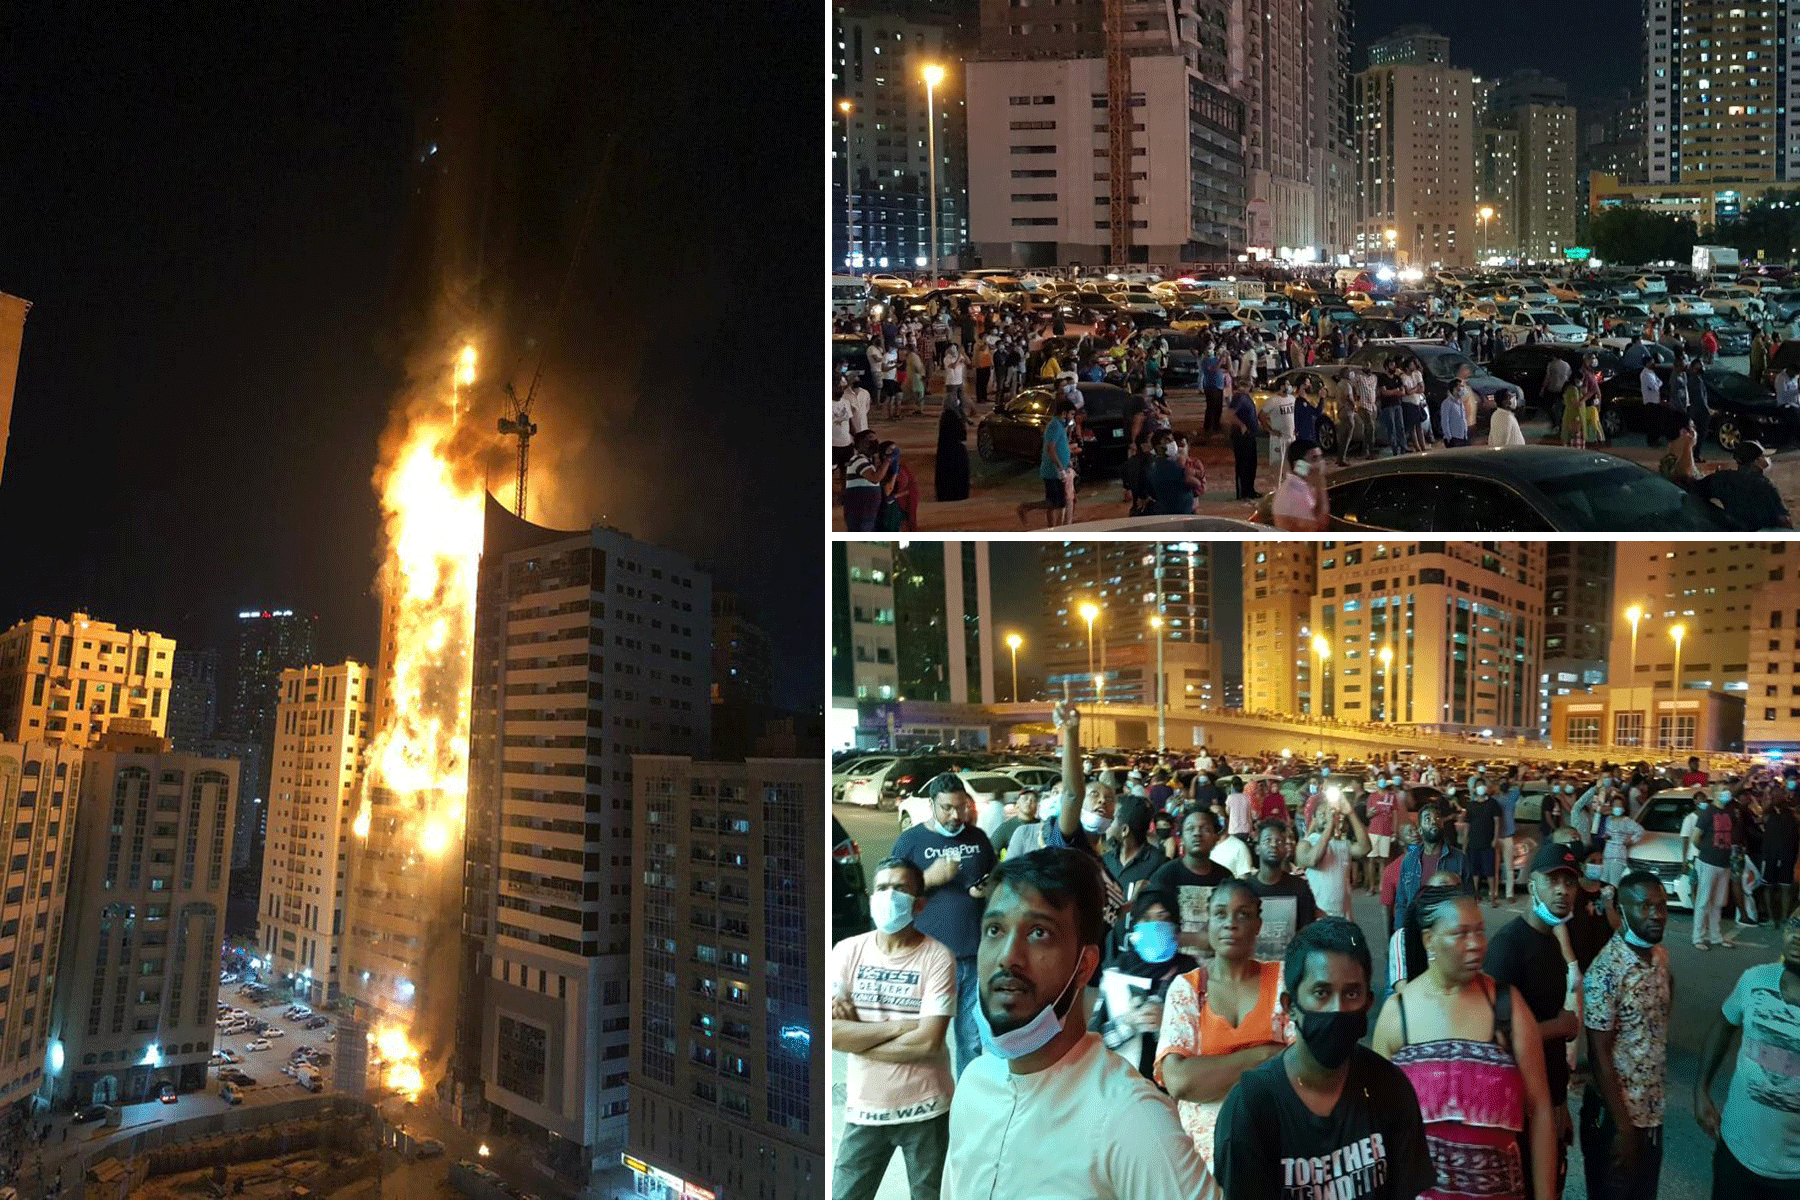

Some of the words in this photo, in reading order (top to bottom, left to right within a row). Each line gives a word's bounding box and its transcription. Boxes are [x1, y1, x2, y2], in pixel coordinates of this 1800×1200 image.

[860, 1110, 890, 1121] THE
[897, 1101, 938, 1119] WAY
[1280, 1132, 1386, 1186] TOGETHER
